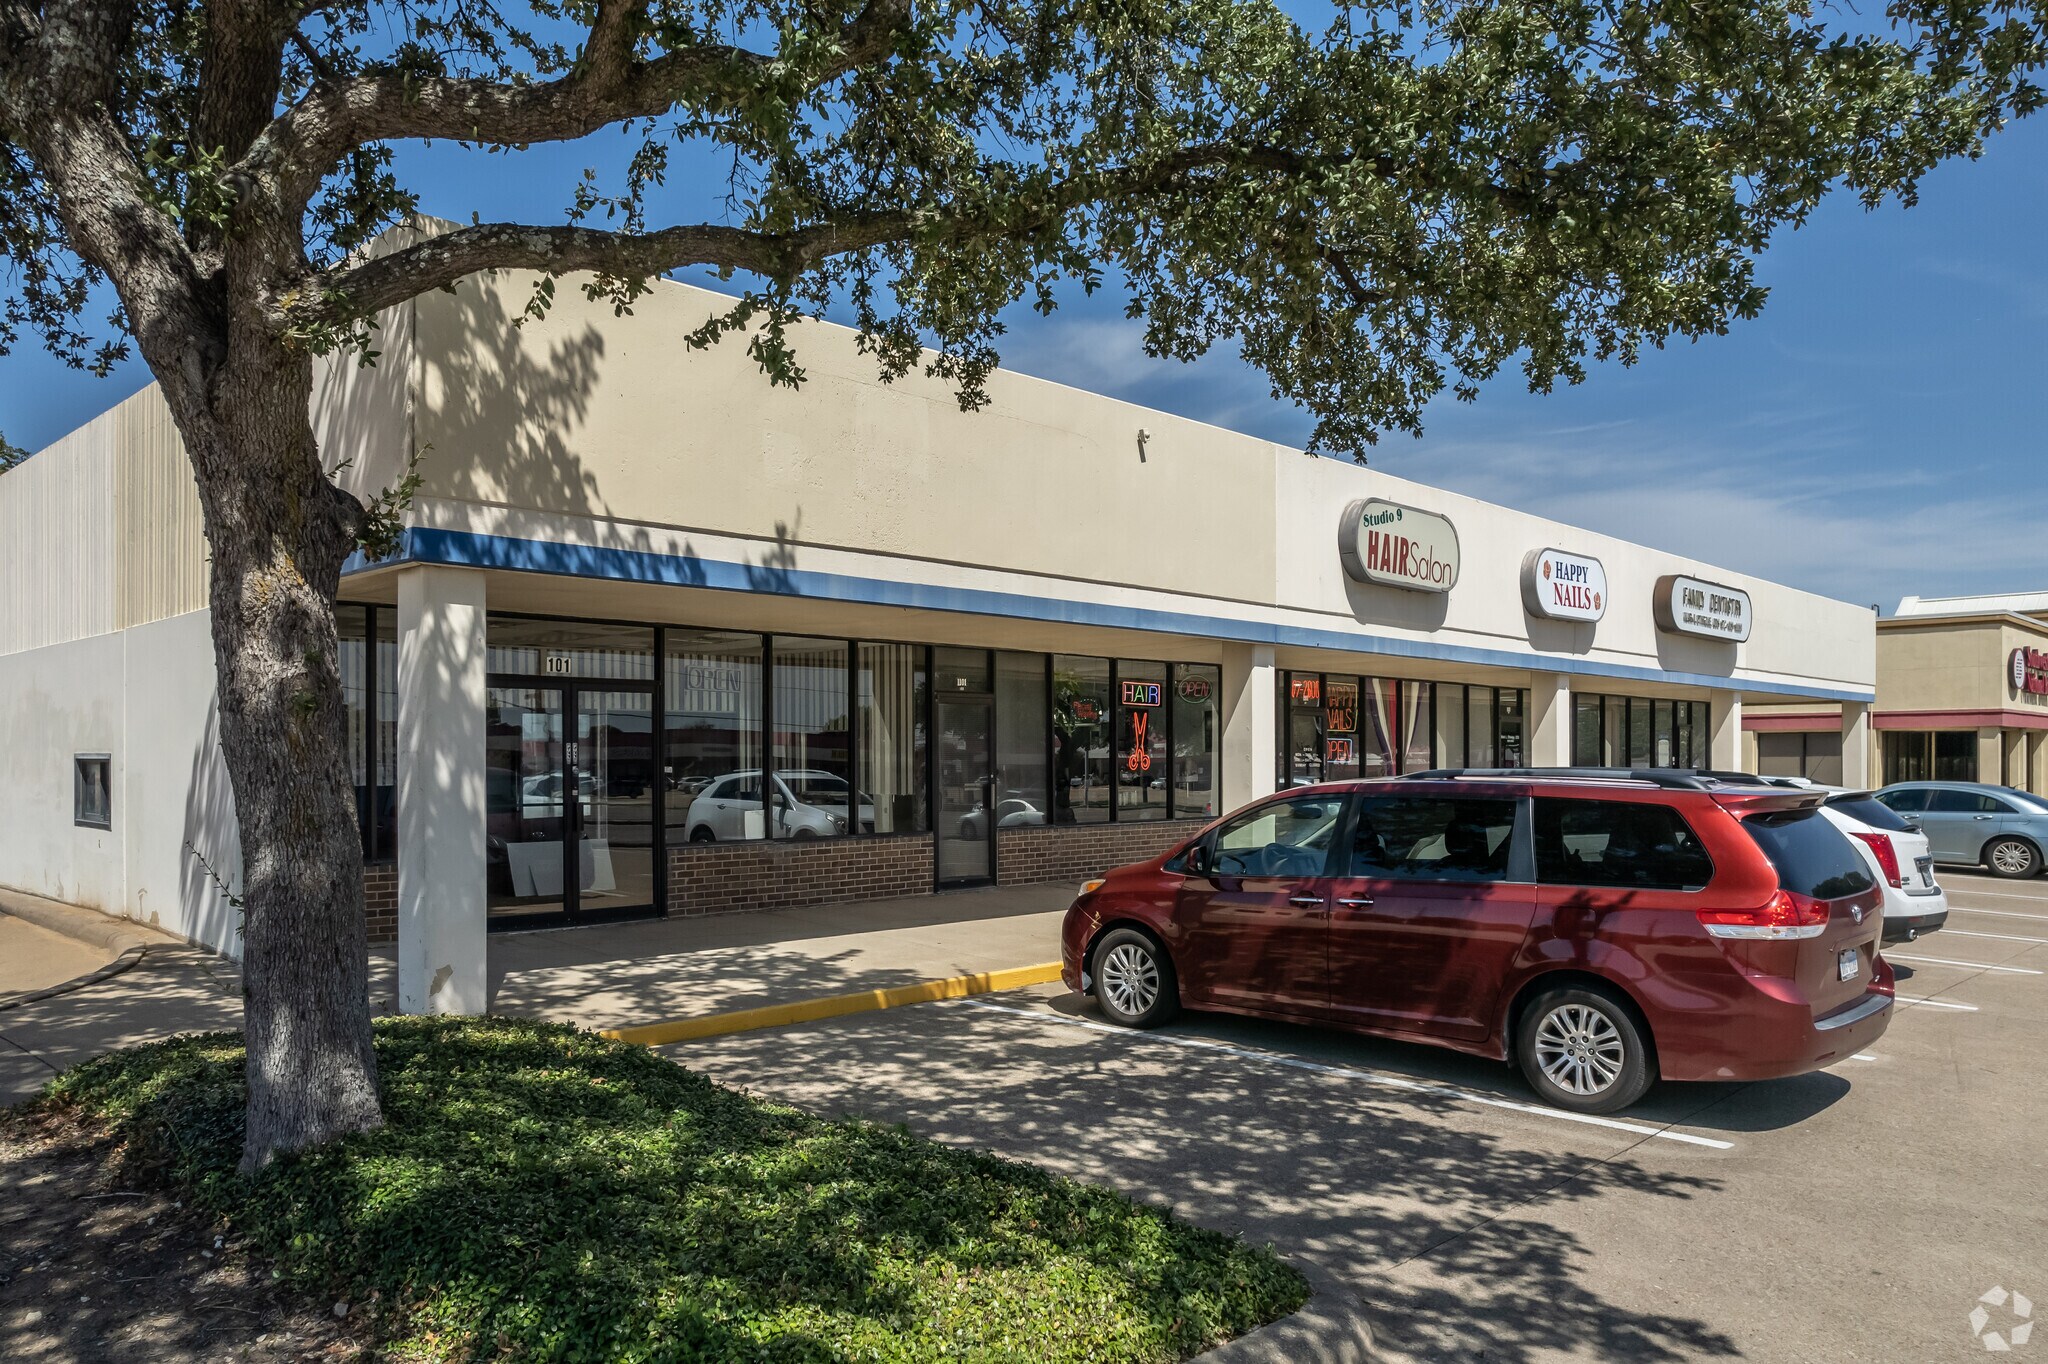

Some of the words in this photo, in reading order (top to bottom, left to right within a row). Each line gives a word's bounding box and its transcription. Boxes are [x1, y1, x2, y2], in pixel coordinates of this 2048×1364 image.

[1363, 510, 1395, 528] Studio
[1396, 508, 1403, 522] 9
[1555, 561, 1589, 584] HAPPY
[1553, 582, 1591, 610] NAILS
[1683, 587, 1706, 610] FAMILY
[548, 657, 569, 673] 101
[689, 667, 741, 692] OPEN
[1181, 681, 1209, 697] OPEN
[1124, 685, 1158, 703] HAIR
